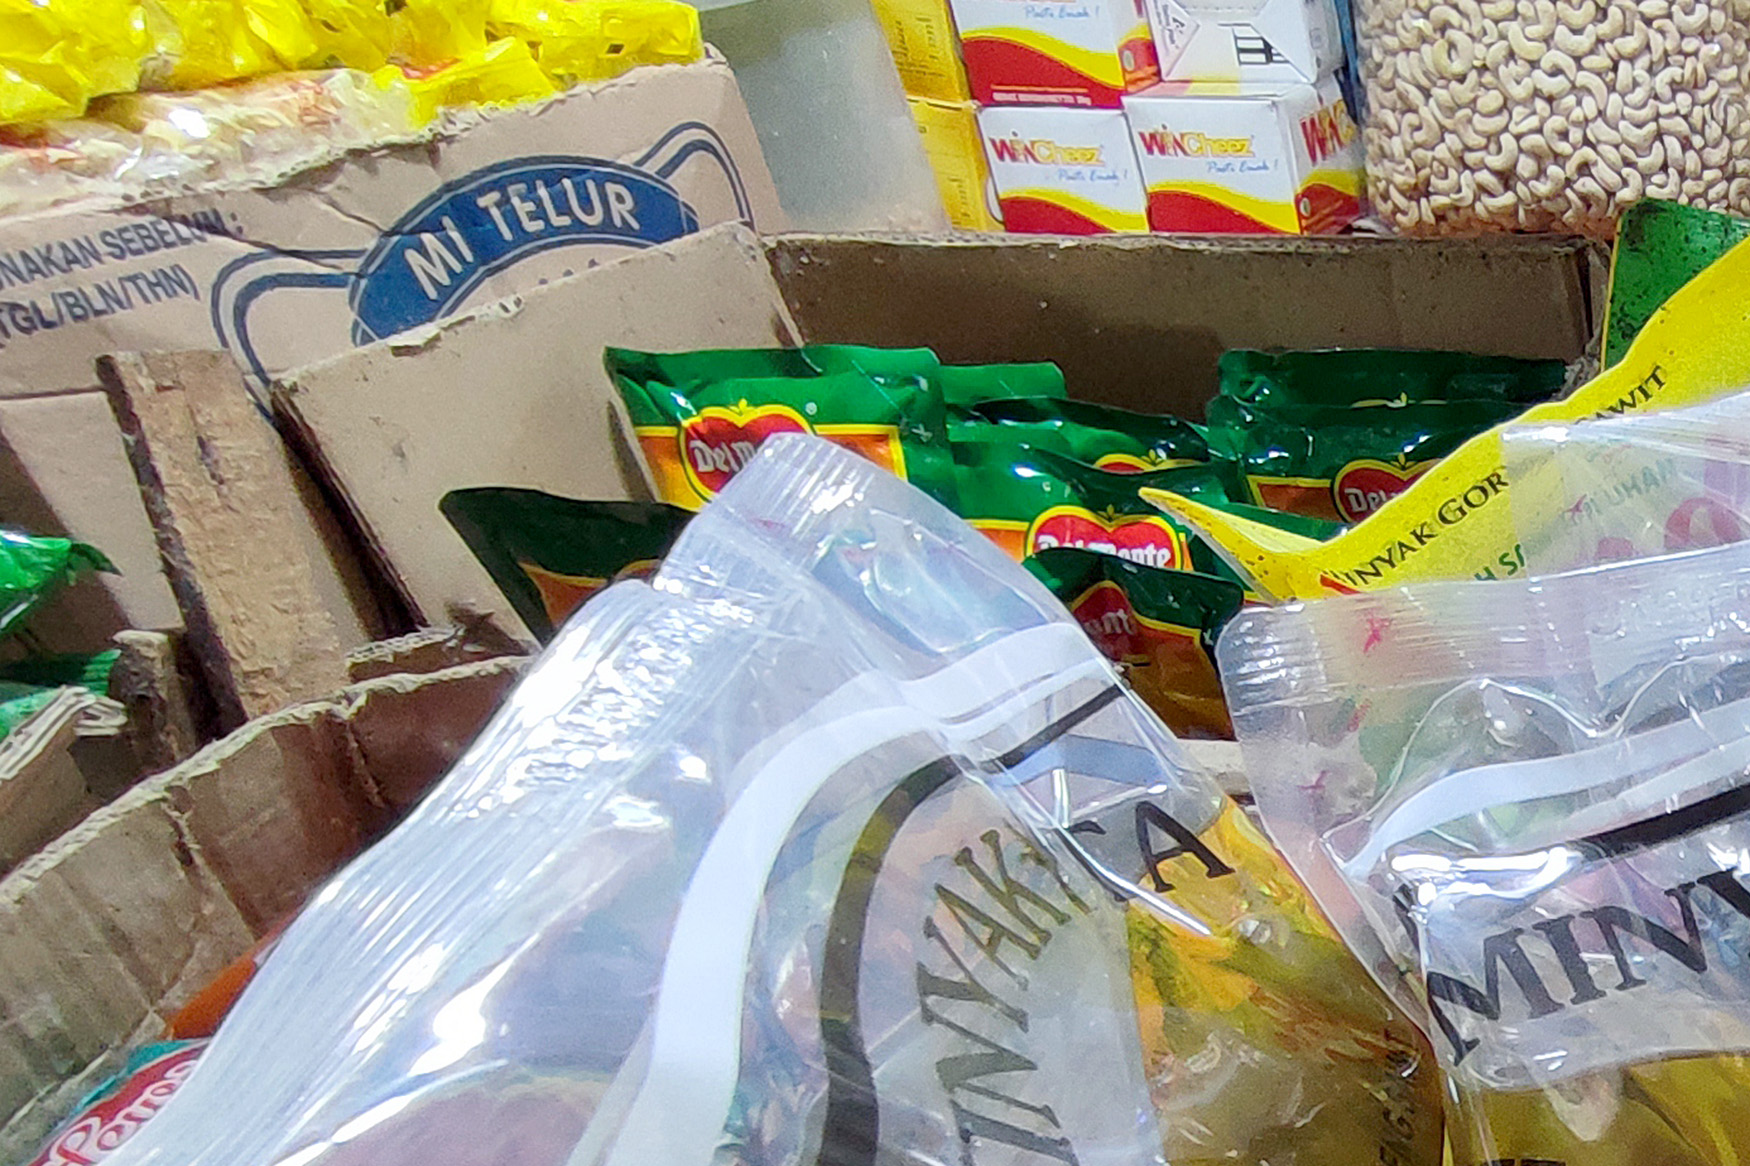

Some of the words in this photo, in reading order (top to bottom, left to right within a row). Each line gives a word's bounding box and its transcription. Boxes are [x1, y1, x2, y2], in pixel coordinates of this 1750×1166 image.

[0, 235, 105, 290] NAKAN
[404, 219, 474, 300] MI
[476, 176, 639, 242] TELUR
[1341, 521, 1438, 588] INYAK
